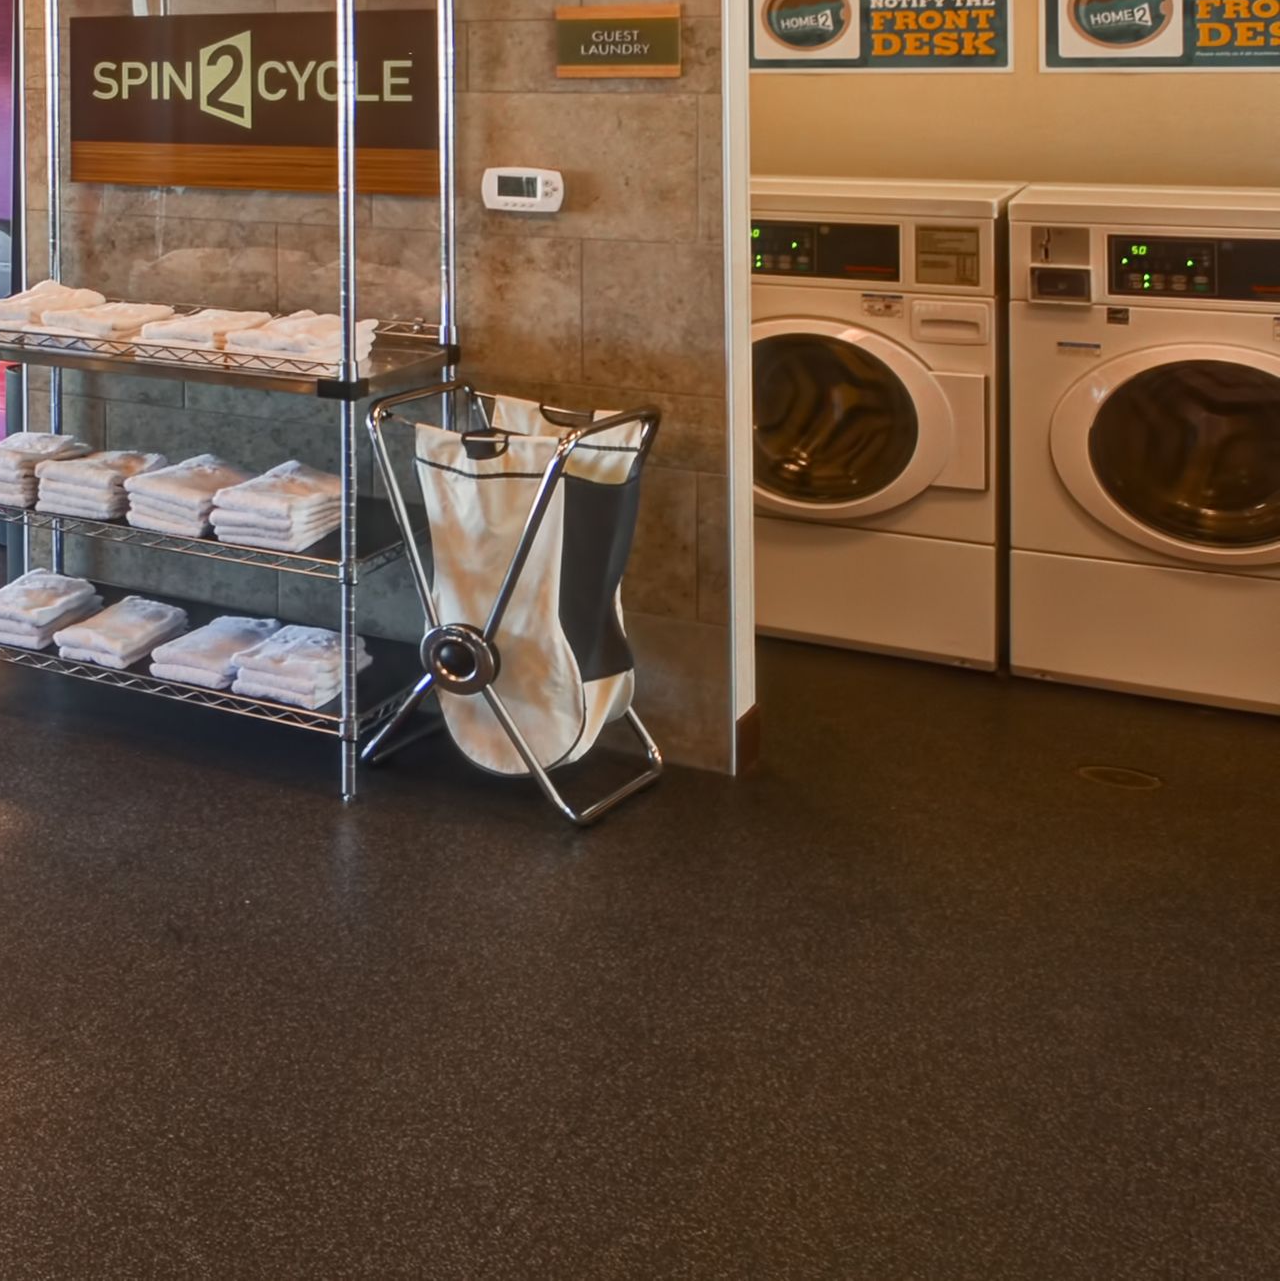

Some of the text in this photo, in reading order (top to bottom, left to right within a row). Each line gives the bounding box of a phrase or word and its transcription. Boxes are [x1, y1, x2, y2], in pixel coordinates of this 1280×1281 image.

[871, 9, 995, 30] FRONT
[591, 30, 640, 42] GUEST
[871, 31, 996, 56] DESK
[580, 43, 650, 55] LAUNDRY
